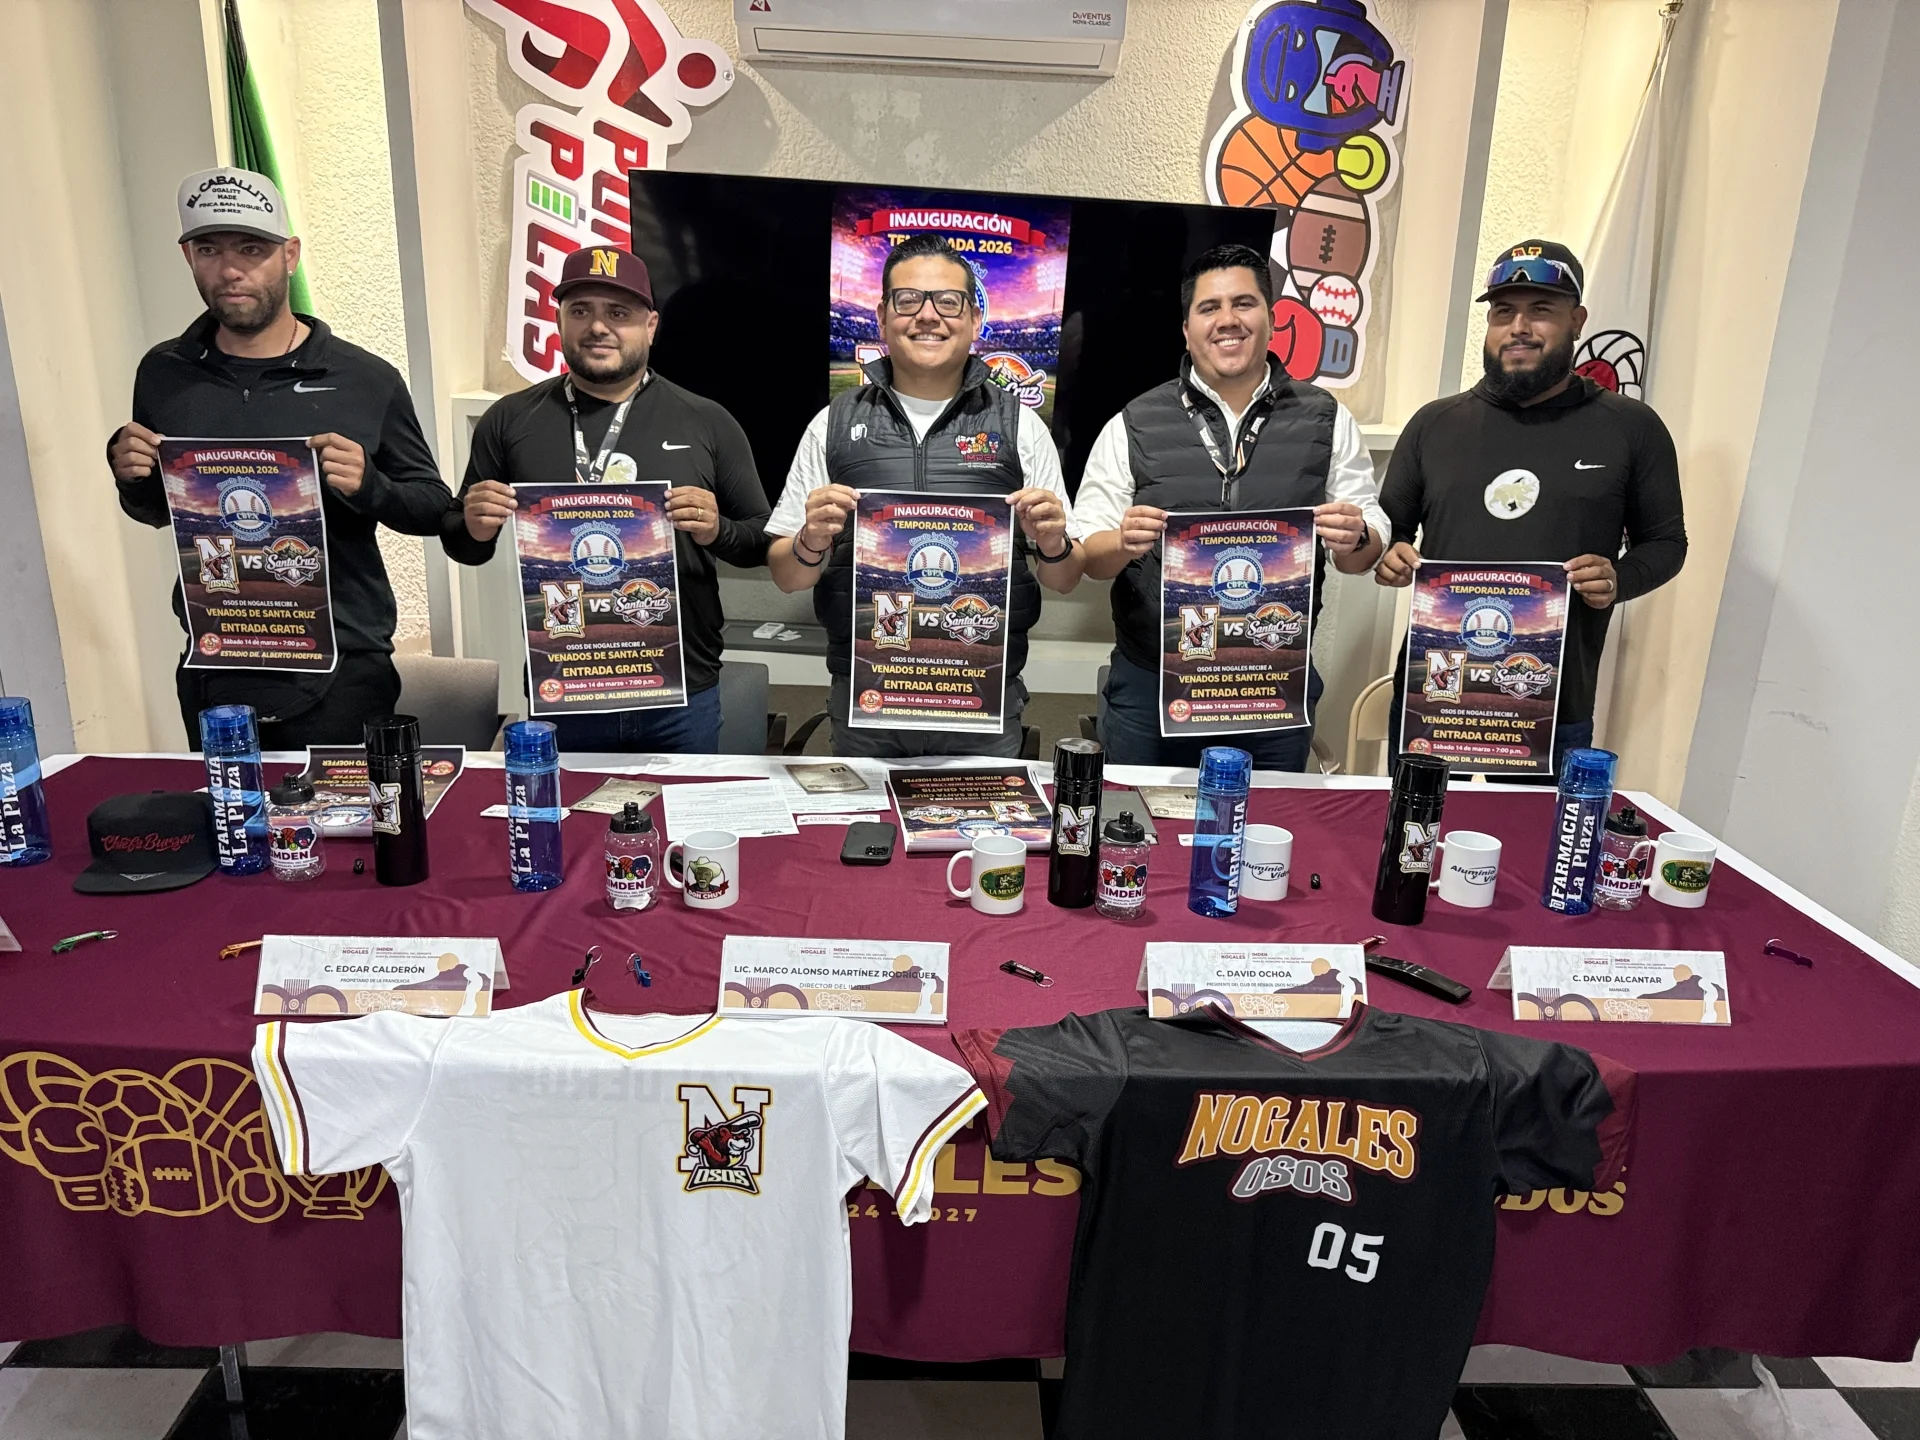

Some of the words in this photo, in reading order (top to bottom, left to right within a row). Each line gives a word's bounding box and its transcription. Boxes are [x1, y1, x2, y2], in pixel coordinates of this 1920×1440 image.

[186, 193, 201, 208] EL
[200, 176, 273, 213] CABALLITO
[237, 203, 265, 212] MIGUEL
[889, 212, 1012, 235] INAUGURACIÓN
[978, 239, 1012, 254] 2026
[590, 249, 619, 277] N
[194, 450, 276, 462] INAUGURACIÓN
[196, 466, 254, 475] TEMPORADA
[257, 466, 279, 474] 2026
[551, 494, 632, 507] INAUGURACIÓN
[552, 511, 611, 520] TEMPORADA
[613, 510, 635, 518] 2026
[894, 506, 974, 519] INAUGURACIÓN
[893, 520, 950, 530] TEMPORADA
[952, 523, 974, 531] 2026
[1200, 520, 1277, 533] INAUGURACIÓN
[1199, 536, 1254, 545] TEMPORADA
[1256, 535, 1278, 543] 2026
[241, 555, 262, 569] VS
[1451, 572, 1531, 585] INAUGURACIÓN
[1450, 585, 1506, 595] TEMPORADA
[1508, 587, 1531, 596] 2026
[589, 599, 611, 613] VS
[206, 608, 247, 617] VENADOS
[250, 609, 260, 617] DE
[263, 610, 291, 618] SANTA
[293, 611, 315, 619] CRUZ
[918, 613, 939, 627] VS
[221, 624, 268, 633] ENTRADA
[270, 625, 305, 634] GRATIS
[1223, 623, 1244, 636] VS
[548, 653, 592, 662] VENADOS
[594, 652, 606, 660] DE
[608, 650, 638, 659] SANTA
[640, 649, 664, 658] CRUZ
[562, 666, 613, 677] ENTRADA
[615, 664, 653, 674] GRATIS
[872, 664, 914, 674] VENADOS
[916, 667, 928, 675] DE
[930, 668, 960, 676] SANTA
[962, 669, 986, 678] CRUZ
[1470, 669, 1491, 682] VS
[1179, 675, 1220, 684] VENADOS
[1235, 673, 1264, 682] SANTA
[1266, 673, 1289, 681] CRUZ
[884, 680, 933, 691] ENTRADA
[935, 682, 973, 693] GRATIS
[1191, 688, 1238, 698] ENTRADA
[1240, 687, 1277, 696] GRATIS
[564, 694, 593, 702] ESTADIO
[608, 691, 639, 700] ALBERTO
[640, 689, 672, 697] HOEFFER
[1421, 716, 1464, 726] VENADOS
[1466, 718, 1477, 726] DE
[1480, 719, 1509, 728] SANTA
[1511, 720, 1536, 729] CRUZ
[1433, 730, 1482, 740] ENTRADA
[1484, 732, 1522, 742] GRATIS
[1, 761, 21, 817] Plaza
[226, 765, 245, 823] Plaza
[208, 756, 229, 859] FARMACIA
[514, 784, 530, 841] Plaza
[10, 823, 28, 851] La
[144, 832, 195, 851] Burger
[232, 827, 248, 856] La
[1572, 814, 1596, 870] Plaza
[1228, 800, 1246, 900] FARMACIA
[1551, 802, 1580, 898] FARMACIA
[517, 846, 533, 875] La
[1240, 860, 1284, 872] Aluminio
[1450, 865, 1496, 876] Aluminio
[1566, 876, 1586, 902] La
[1604, 879, 1641, 890] IMDEN
[703, 889, 723, 899] CHUY
[1105, 887, 1142, 897] IMDEN
[324, 965, 333, 973] C.
[336, 965, 369, 973] EDGAR
[371, 964, 425, 974] CALDERÓN
[734, 965, 751, 973] LIC.
[754, 967, 788, 975] MARCO
[791, 967, 830, 976] ALONSO
[832, 967, 880, 978] MARTÍNEZ
[1227, 970, 1257, 978] DAVID
[1258, 970, 1292, 978] OCHOA
[1572, 975, 1582, 983] C.
[1583, 975, 1612, 983] DAVID
[1614, 976, 1662, 984] ALCANTAR
[679, 1084, 771, 1175] N
[1178, 1094, 1417, 1179] NOGALES
[694, 1168, 751, 1187] OSOS
[1232, 1155, 1352, 1201] OSOS
[1307, 1222, 1385, 1283] 05
